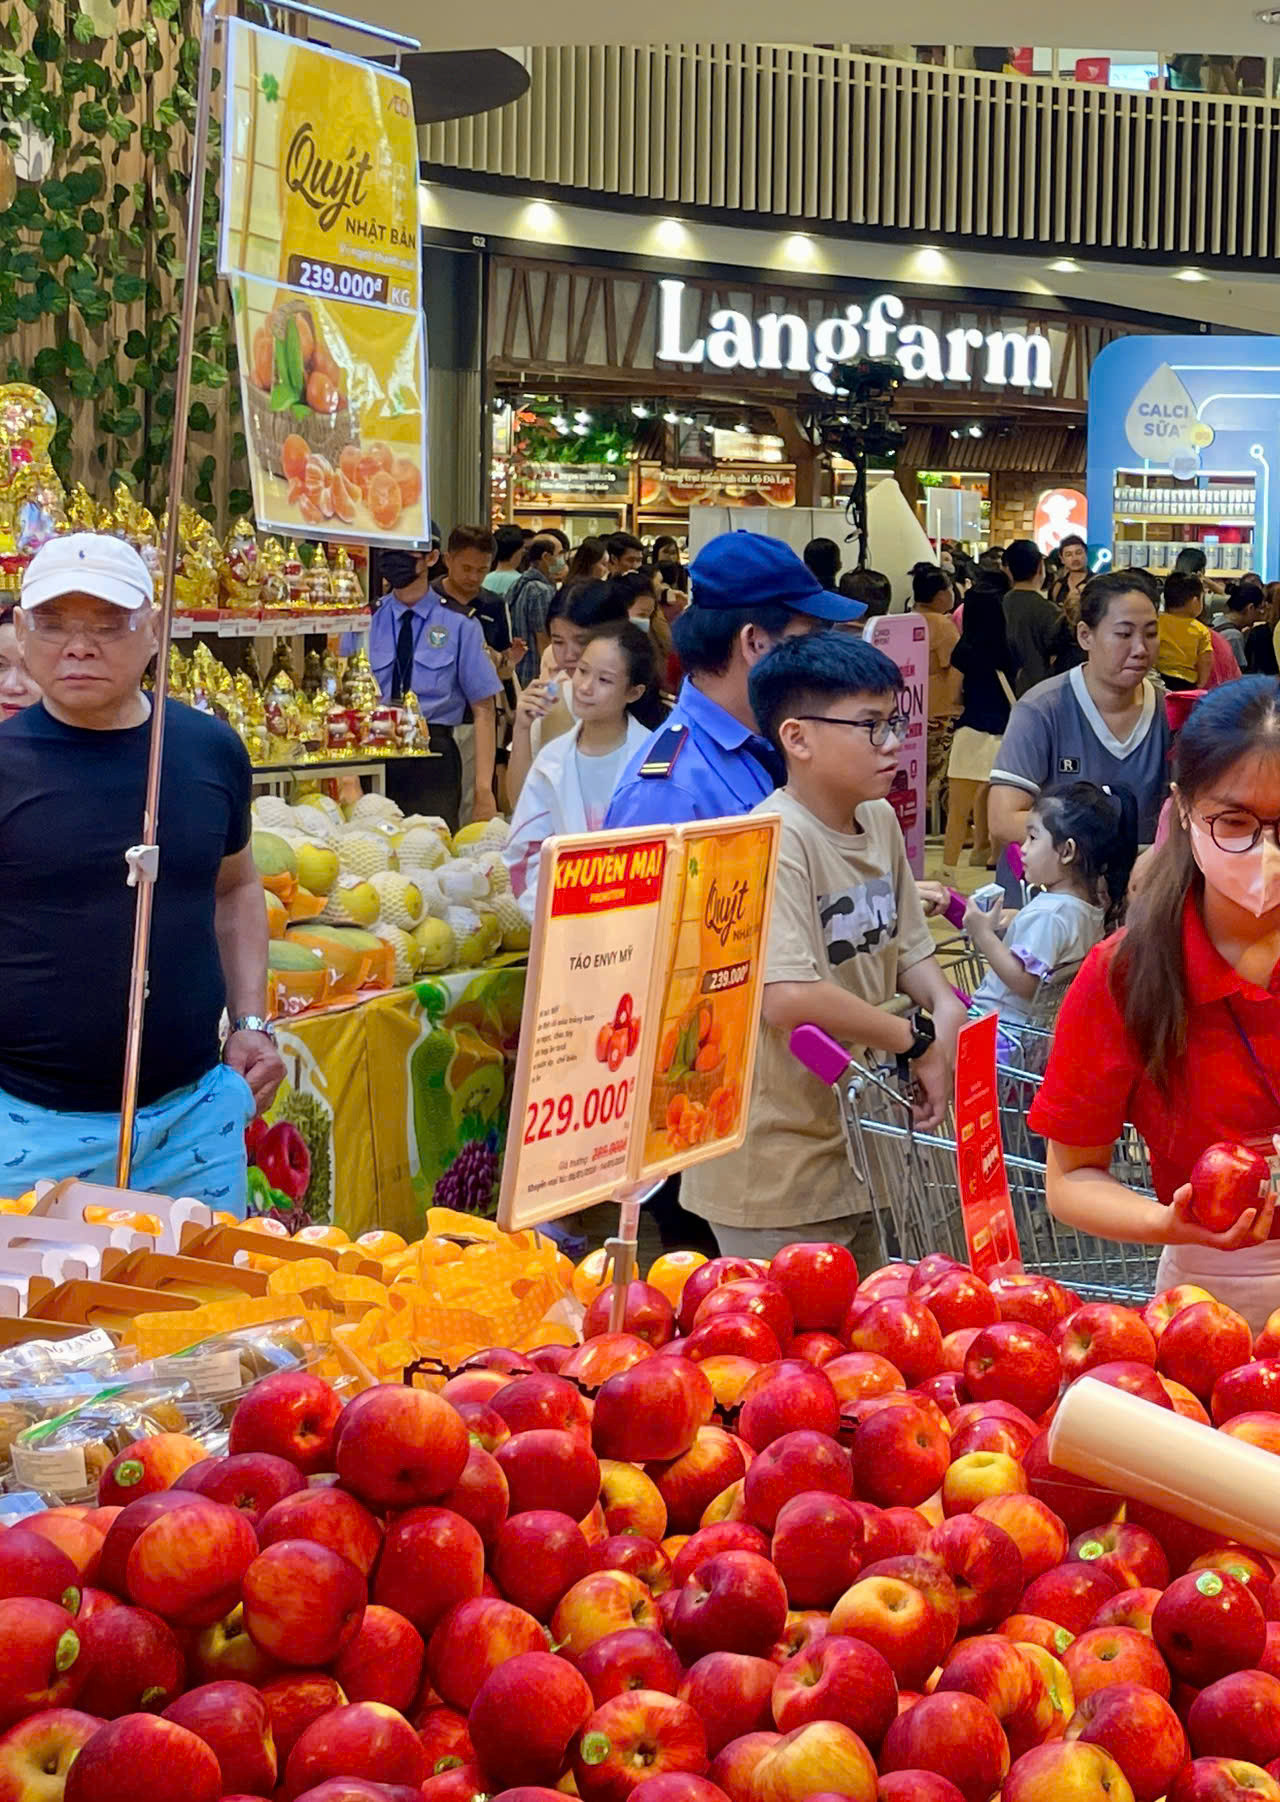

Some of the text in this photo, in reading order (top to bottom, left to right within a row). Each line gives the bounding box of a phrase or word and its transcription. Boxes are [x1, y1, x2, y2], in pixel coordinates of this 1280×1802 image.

[285, 122, 374, 233] Quýt
[345, 217, 416, 249] NHẬT BẢN
[391, 287, 411, 307] KG
[658, 280, 1053, 396] Langfarm
[1138, 403, 1189, 418] CALCI
[1144, 420, 1180, 437] SỮA
[629, 847, 664, 886] MẠI
[705, 877, 748, 947] Quýt
[569, 952, 591, 971] TÁO
[594, 951, 617, 968] ENVY
